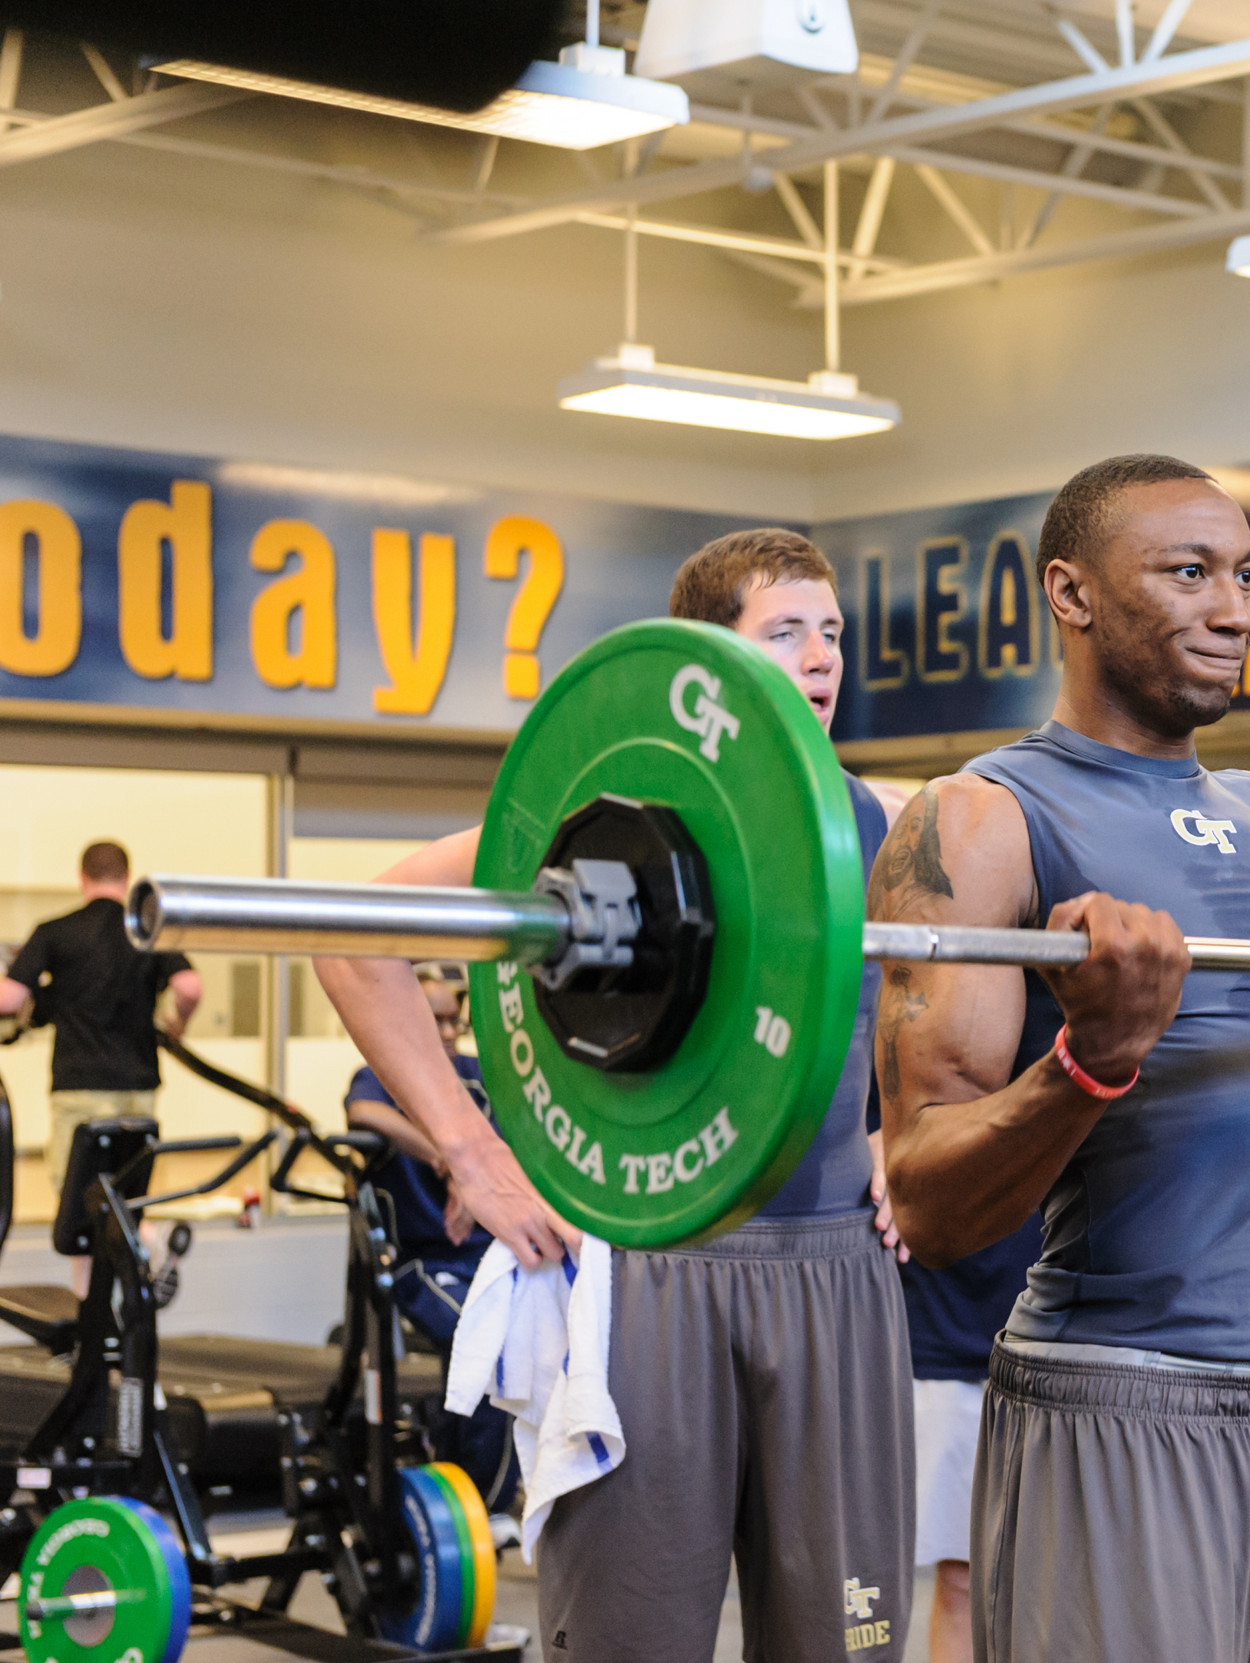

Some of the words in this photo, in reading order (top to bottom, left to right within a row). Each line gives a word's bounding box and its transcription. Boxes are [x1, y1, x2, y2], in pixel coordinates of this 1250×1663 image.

[0, 479, 564, 715] oday?
[669, 663, 741, 764] GT
[1170, 808, 1237, 854] GT
[754, 1005, 792, 1058] 10
[618, 1106, 738, 1195] TECH
